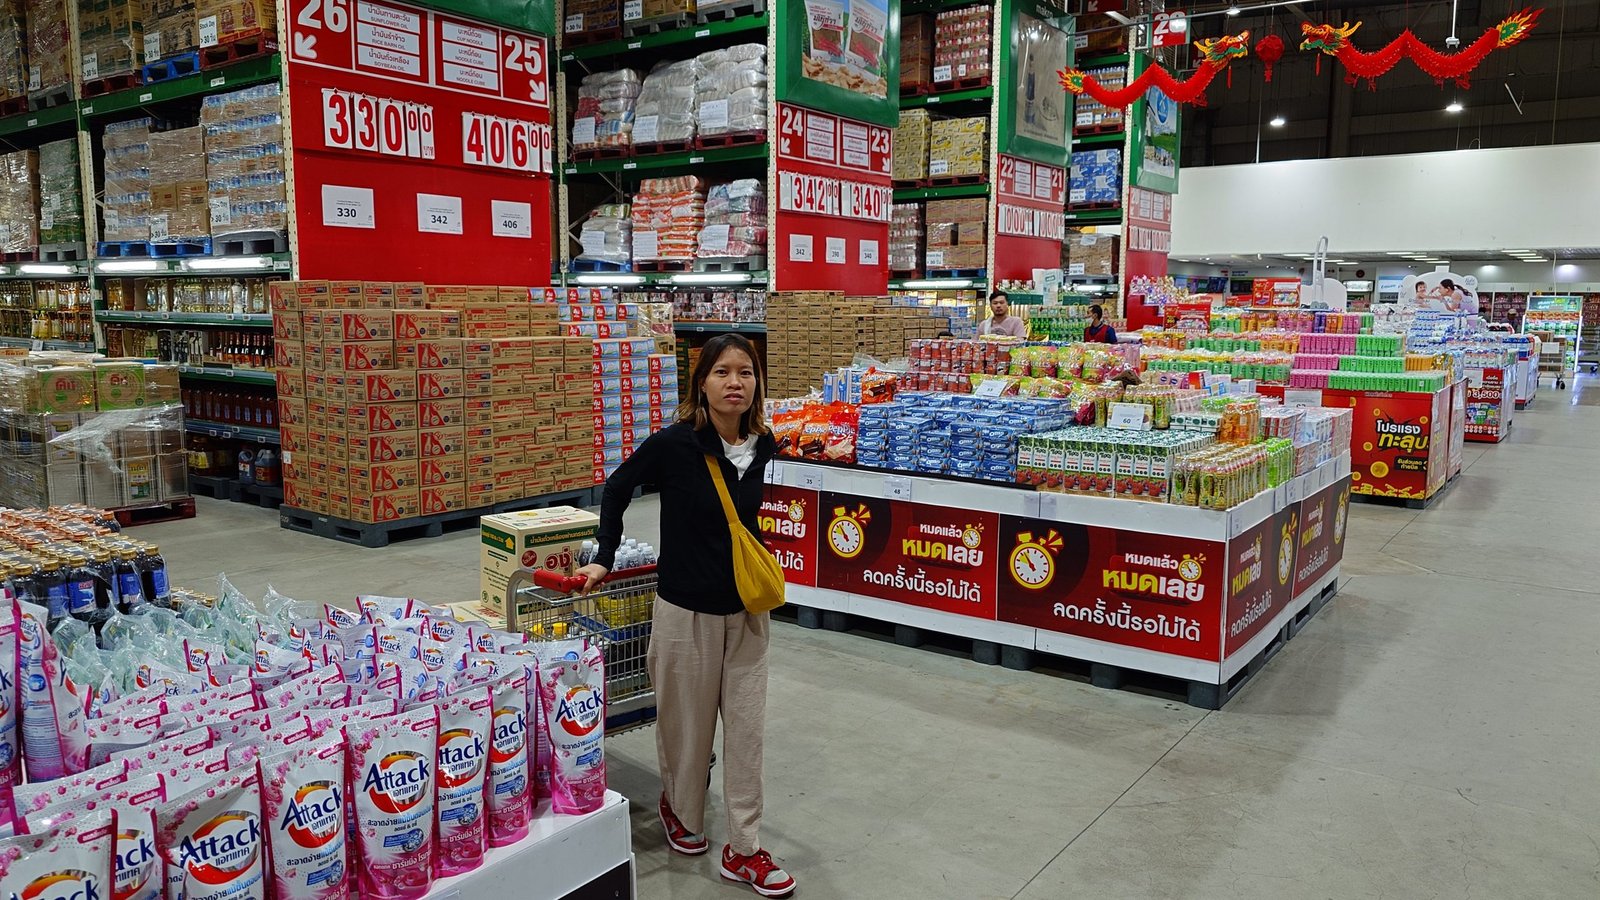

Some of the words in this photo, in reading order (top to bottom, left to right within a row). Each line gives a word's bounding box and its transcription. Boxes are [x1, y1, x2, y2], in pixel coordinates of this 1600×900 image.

[297, 0, 348, 33] 26
[371, 17, 400, 27] SUNFLOWER
[504, 34, 542, 75] 25
[782, 107, 803, 136] 24
[872, 128, 889, 154] 23
[1001, 157, 1013, 178] 22
[1052, 169, 1062, 187] 21
[336, 208, 356, 218] 330
[430, 214, 448, 225] 342
[502, 220, 518, 229] 406
[1376, 420, 1421, 434] โปรแรง
[1378, 434, 1429, 453] ทะลุป
[920, 524, 962, 539] หมดแล้ว
[902, 537, 984, 567] หมดเลย
[1124, 552, 1179, 570] หมดแล้ว
[863, 564, 981, 603] ลดครั้งนี้รอไม่ได้
[1102, 568, 1205, 602] หมดเลย
[1232, 560, 1262, 597] หมดเลย
[432, 622, 454, 636] Attack
[1053, 598, 1201, 642] ลดครั้งนี้รอไม่ได้
[555, 689, 604, 722] Attack
[439, 735, 484, 764] ttack
[363, 759, 430, 792] Attack
[280, 787, 342, 831] Attack
[115, 838, 155, 869] ack
[180, 819, 260, 868] Attack
[215, 847, 250, 867] แอทแทค
